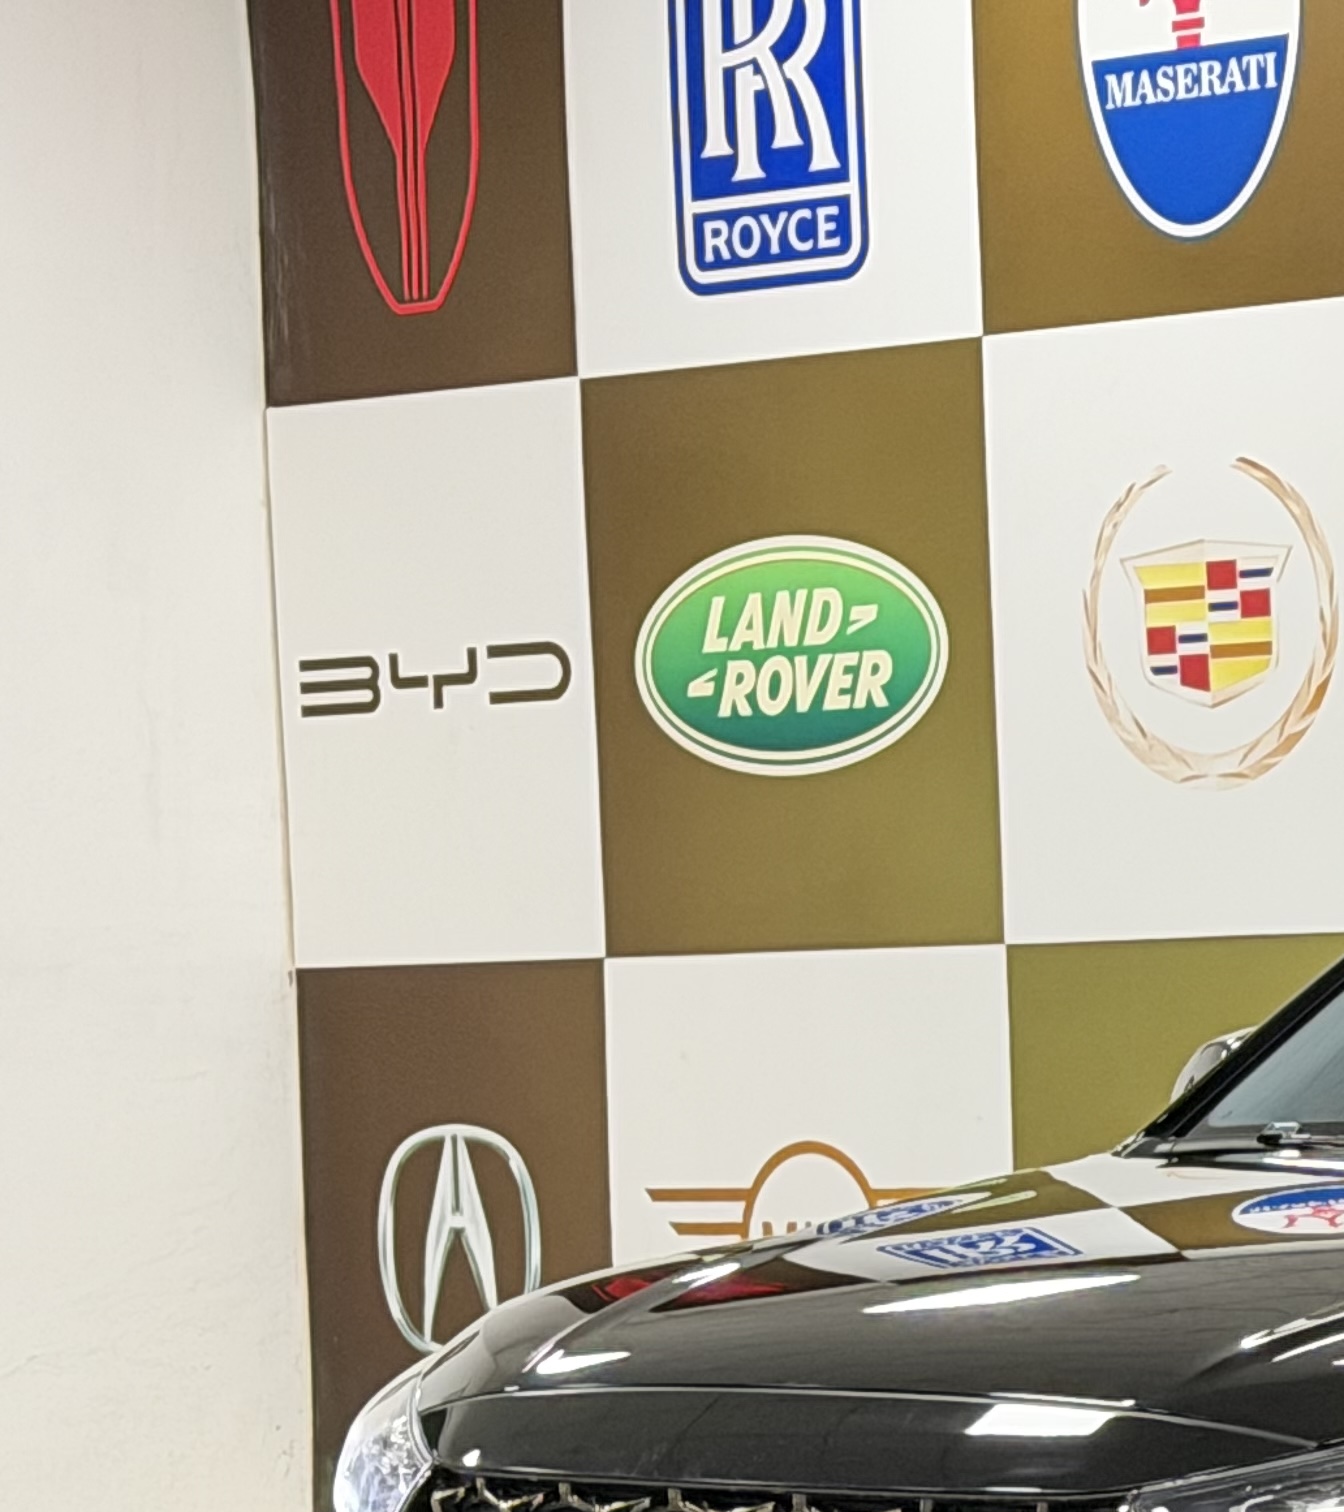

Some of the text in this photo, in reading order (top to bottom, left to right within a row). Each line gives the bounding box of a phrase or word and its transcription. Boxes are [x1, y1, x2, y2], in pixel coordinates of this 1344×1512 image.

[1104, 51, 1278, 110] MASERATI
[702, 205, 841, 263] ROYCE
[701, 586, 843, 654] LAND
[298, 640, 573, 718] BYD
[717, 648, 894, 718] ROVER
